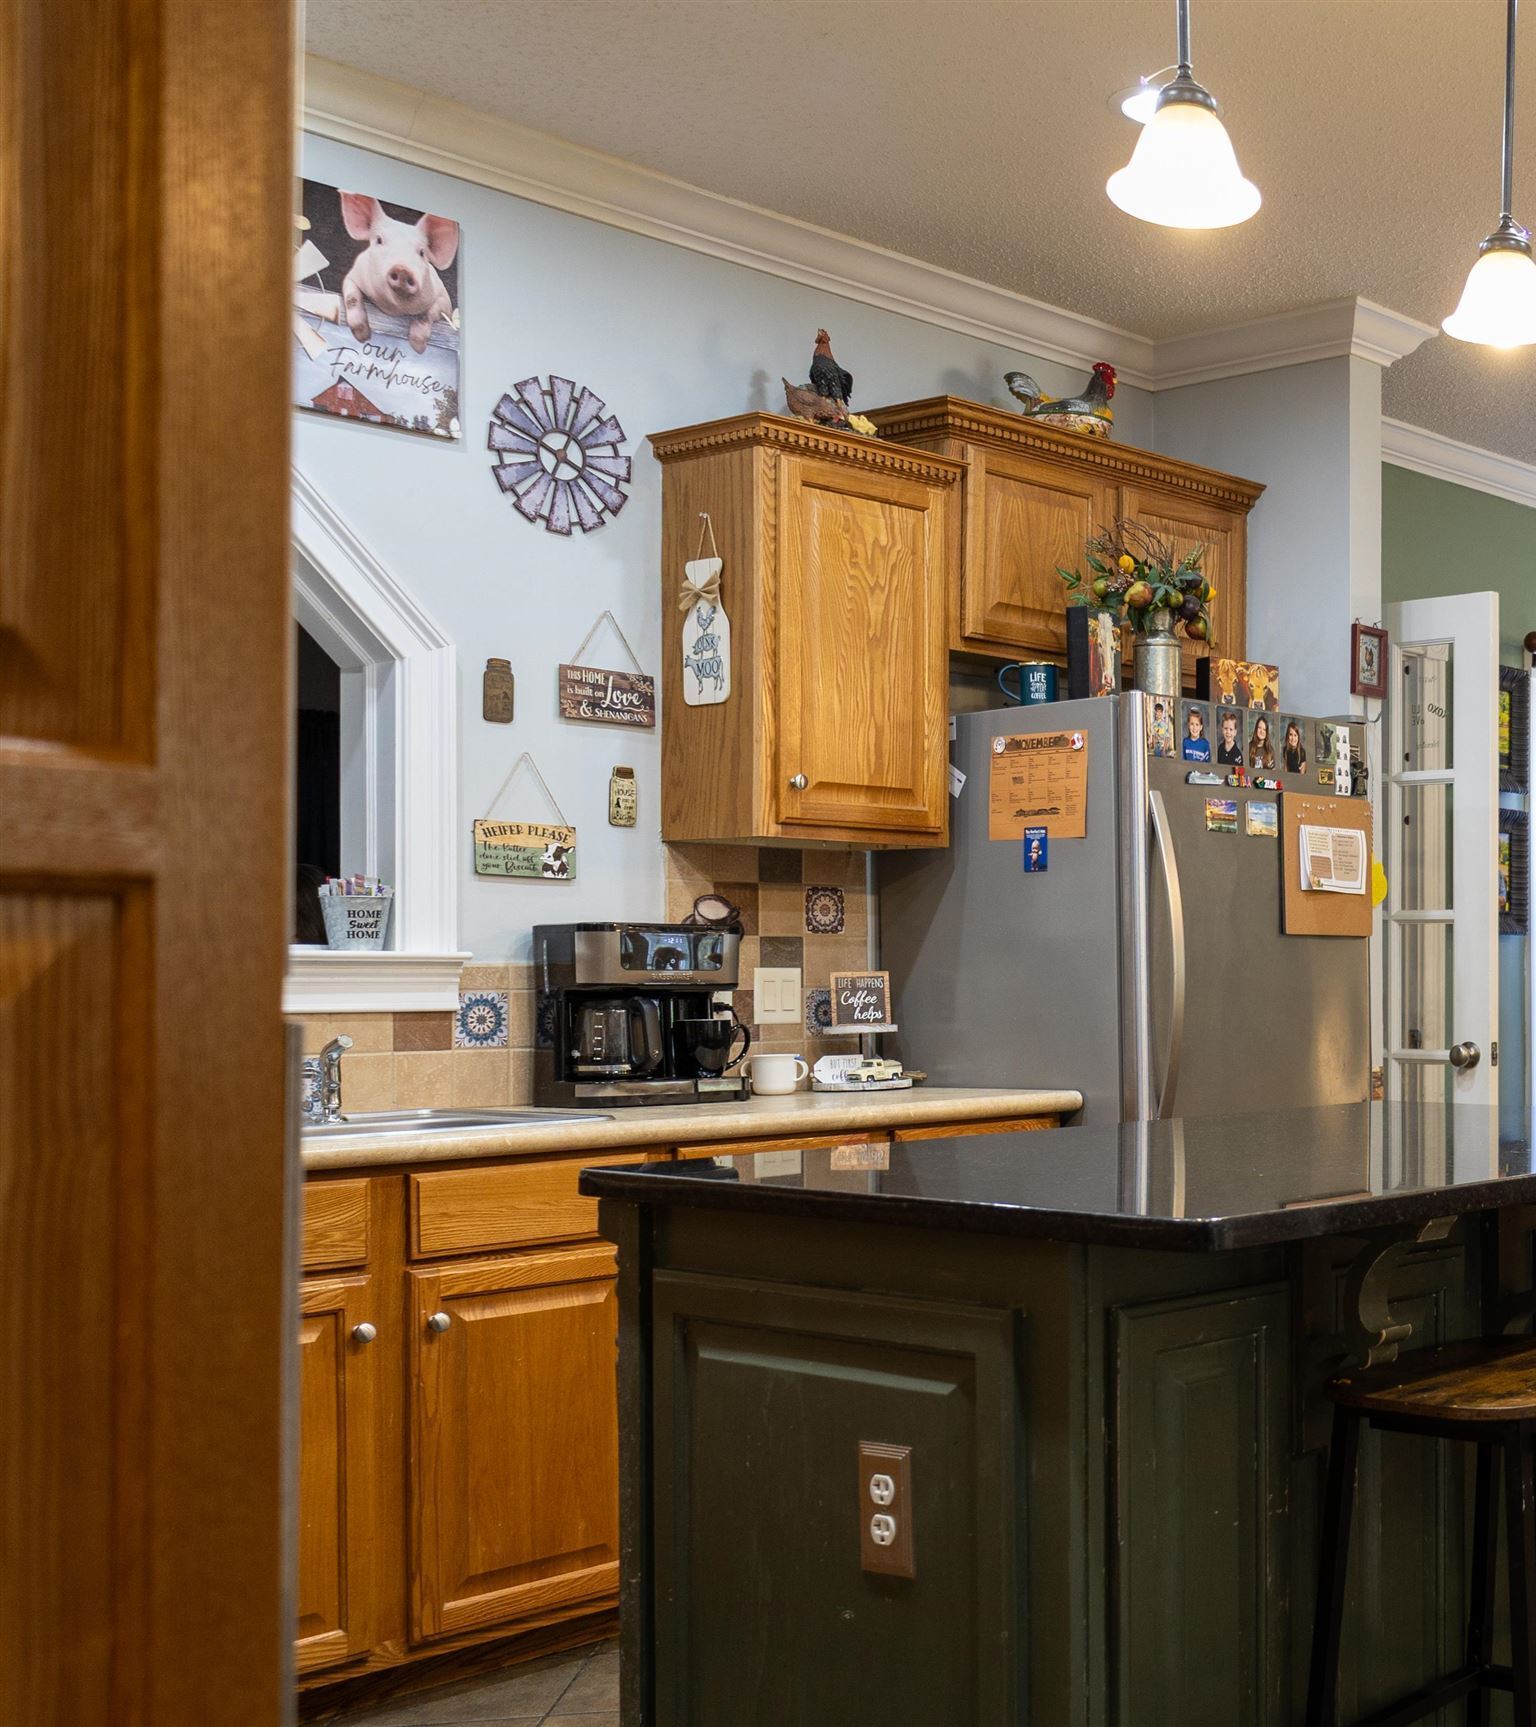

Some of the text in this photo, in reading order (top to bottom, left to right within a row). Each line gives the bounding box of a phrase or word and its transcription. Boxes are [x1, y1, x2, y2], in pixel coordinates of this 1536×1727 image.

[363, 342, 407, 362] our
[327, 346, 446, 395] Farmhouse
[696, 660, 720, 676] MOO
[567, 669, 606, 686] THIS HOME
[1029, 671, 1047, 683] LIFE
[567, 675, 643, 709] is built on Love
[580, 699, 648, 723] & SHENANIGANS
[482, 824, 571, 844] HEIFER PLEASE
[479, 840, 498, 851] The
[347, 909, 382, 919] HOME
[349, 919, 380, 929] Sweet
[346, 930, 381, 939] HOME
[838, 977, 884, 989] LIFE HAPPENS
[841, 990, 878, 1007] Coffee
[854, 1005, 884, 1023] helps
